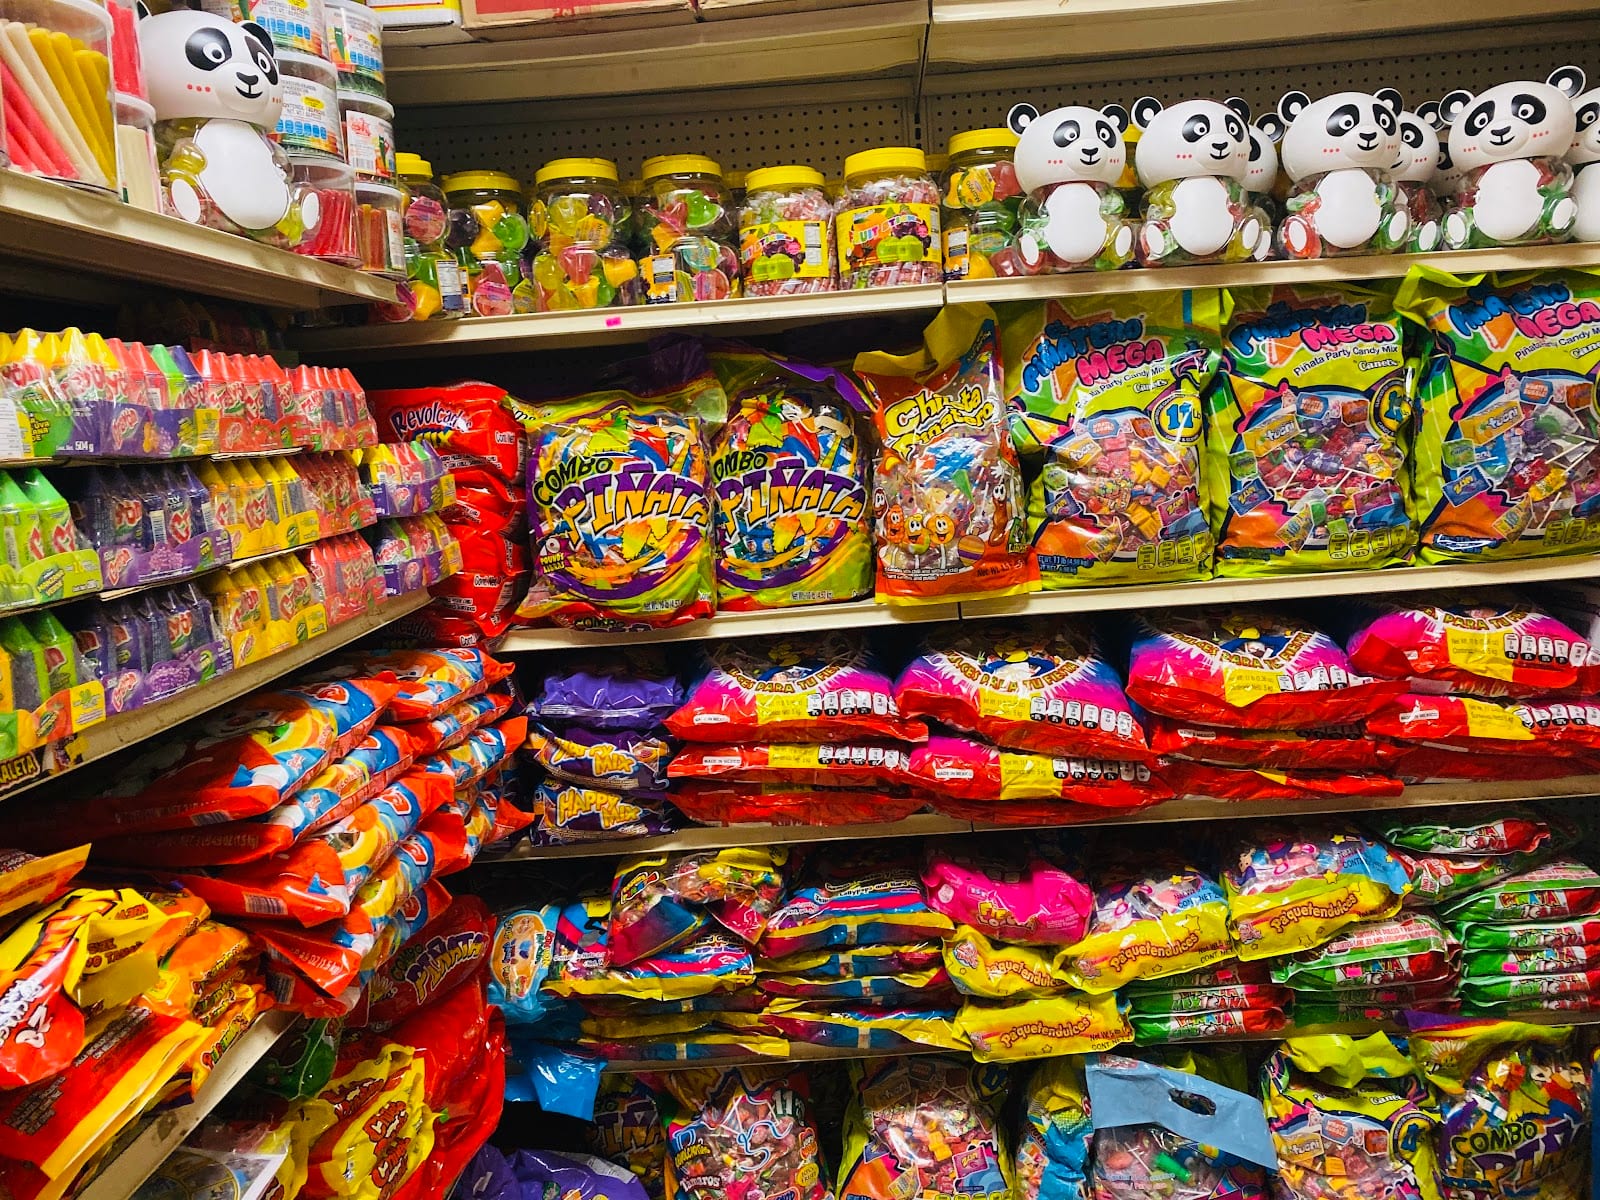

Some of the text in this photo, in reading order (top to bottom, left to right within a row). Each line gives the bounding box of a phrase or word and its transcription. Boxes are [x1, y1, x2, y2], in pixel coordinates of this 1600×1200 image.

[1301, 324, 1396, 352] MEGA
[1558, 330, 1591, 346] Candy
[1075, 339, 1166, 387] MEGA
[1293, 345, 1398, 377] Piñata Party Candy Mix
[1100, 364, 1166, 393] Party Candy Mix
[1166, 403, 1194, 431] 11
[533, 456, 614, 506] COMBO
[714, 450, 768, 482] OMBO
[553, 461, 712, 549] PIÑATA
[716, 457, 867, 539] PIÑATA
[1442, 613, 1489, 630] PARA
[1022, 676, 1043, 690] TU
[1044, 658, 1080, 685] FIESTA
[1221, 651, 1263, 669] PARA
[755, 681, 796, 695] PARA
[797, 677, 816, 690] TU
[0, 751, 39, 785] ALETA
[593, 752, 634, 776] MIX
[557, 788, 620, 826] HAPPY
[601, 805, 642, 829] MIX
[773, 1090, 793, 1115] 11
[1451, 1120, 1538, 1159] COMBO
